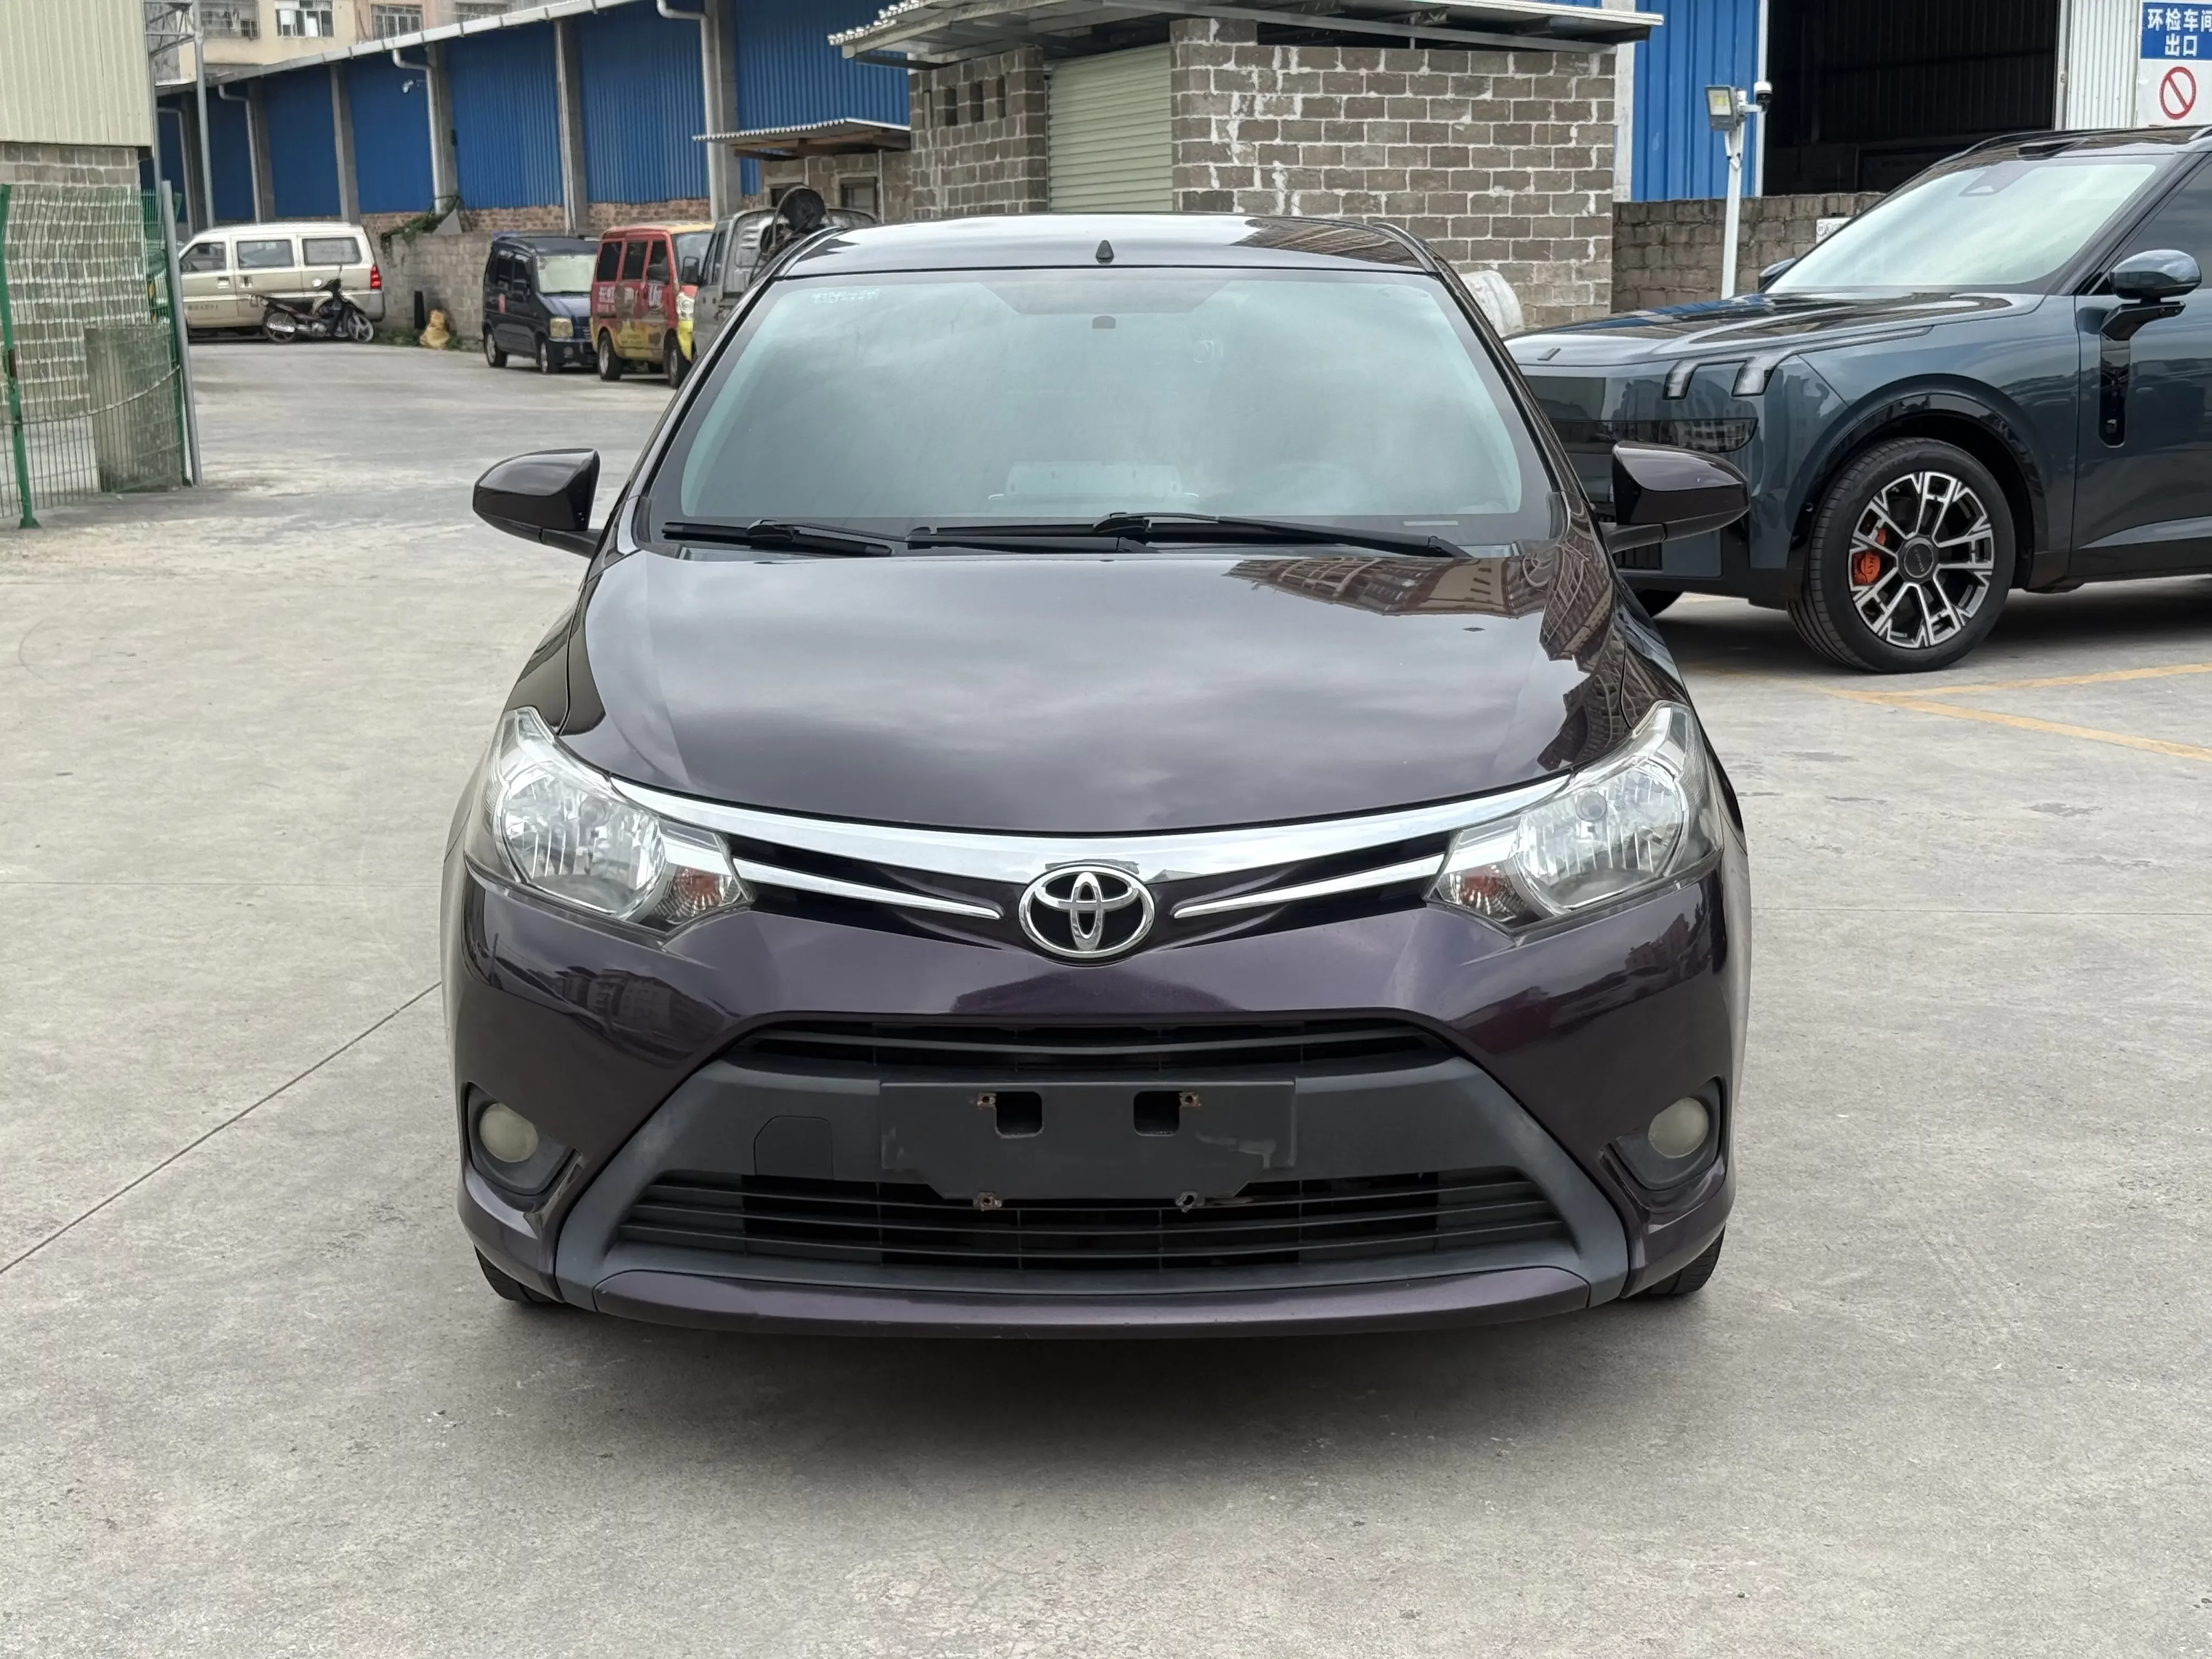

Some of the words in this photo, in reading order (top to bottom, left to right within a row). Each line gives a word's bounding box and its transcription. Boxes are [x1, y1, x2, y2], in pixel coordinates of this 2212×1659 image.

[2147, 8, 2212, 32] 环检车间
[2164, 33, 2198, 57] 出口
